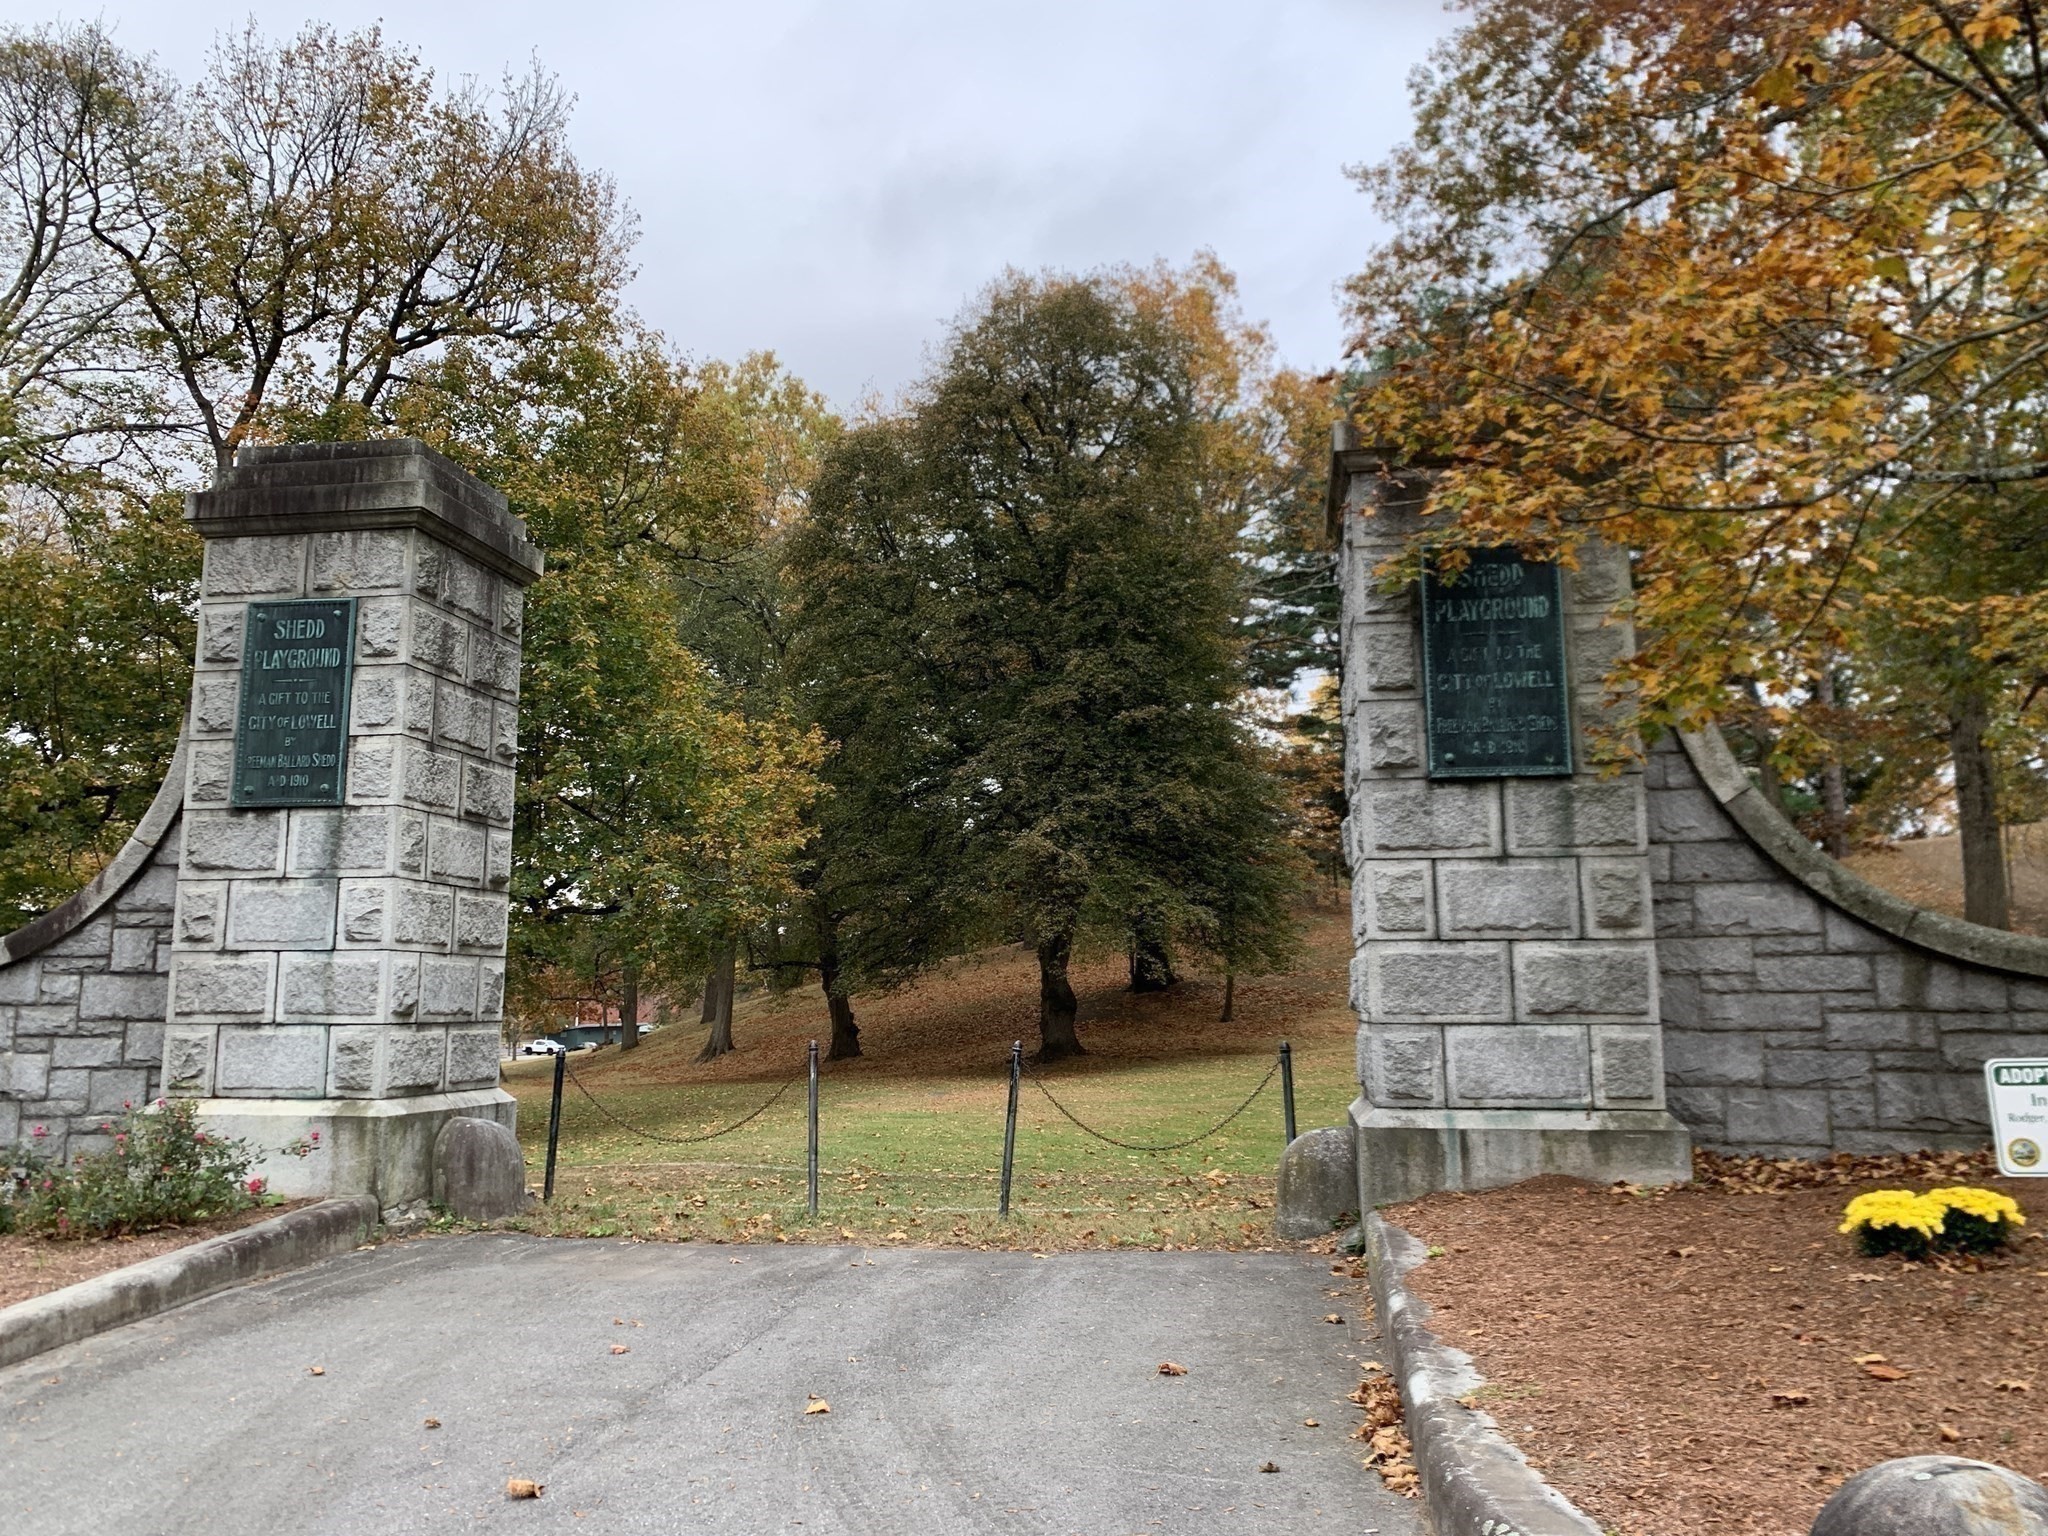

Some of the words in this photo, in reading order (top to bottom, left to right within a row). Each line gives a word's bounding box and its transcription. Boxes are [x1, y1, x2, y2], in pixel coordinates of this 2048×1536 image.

[1435, 595, 1549, 622] PLAYGROUND
[273, 618, 325, 639] SHEDD
[254, 648, 340, 669] PLAYGROUND
[1516, 643, 1542, 659] THE
[1493, 670, 1554, 689] LOWELL
[258, 693, 267, 705] A
[268, 692, 292, 705] GIFT
[295, 691, 308, 705] TO
[312, 691, 330, 704] THE
[248, 715, 276, 730] CITY
[277, 716, 290, 728] OF
[290, 713, 336, 730] LOWELL
[284, 736, 297, 747] BY
